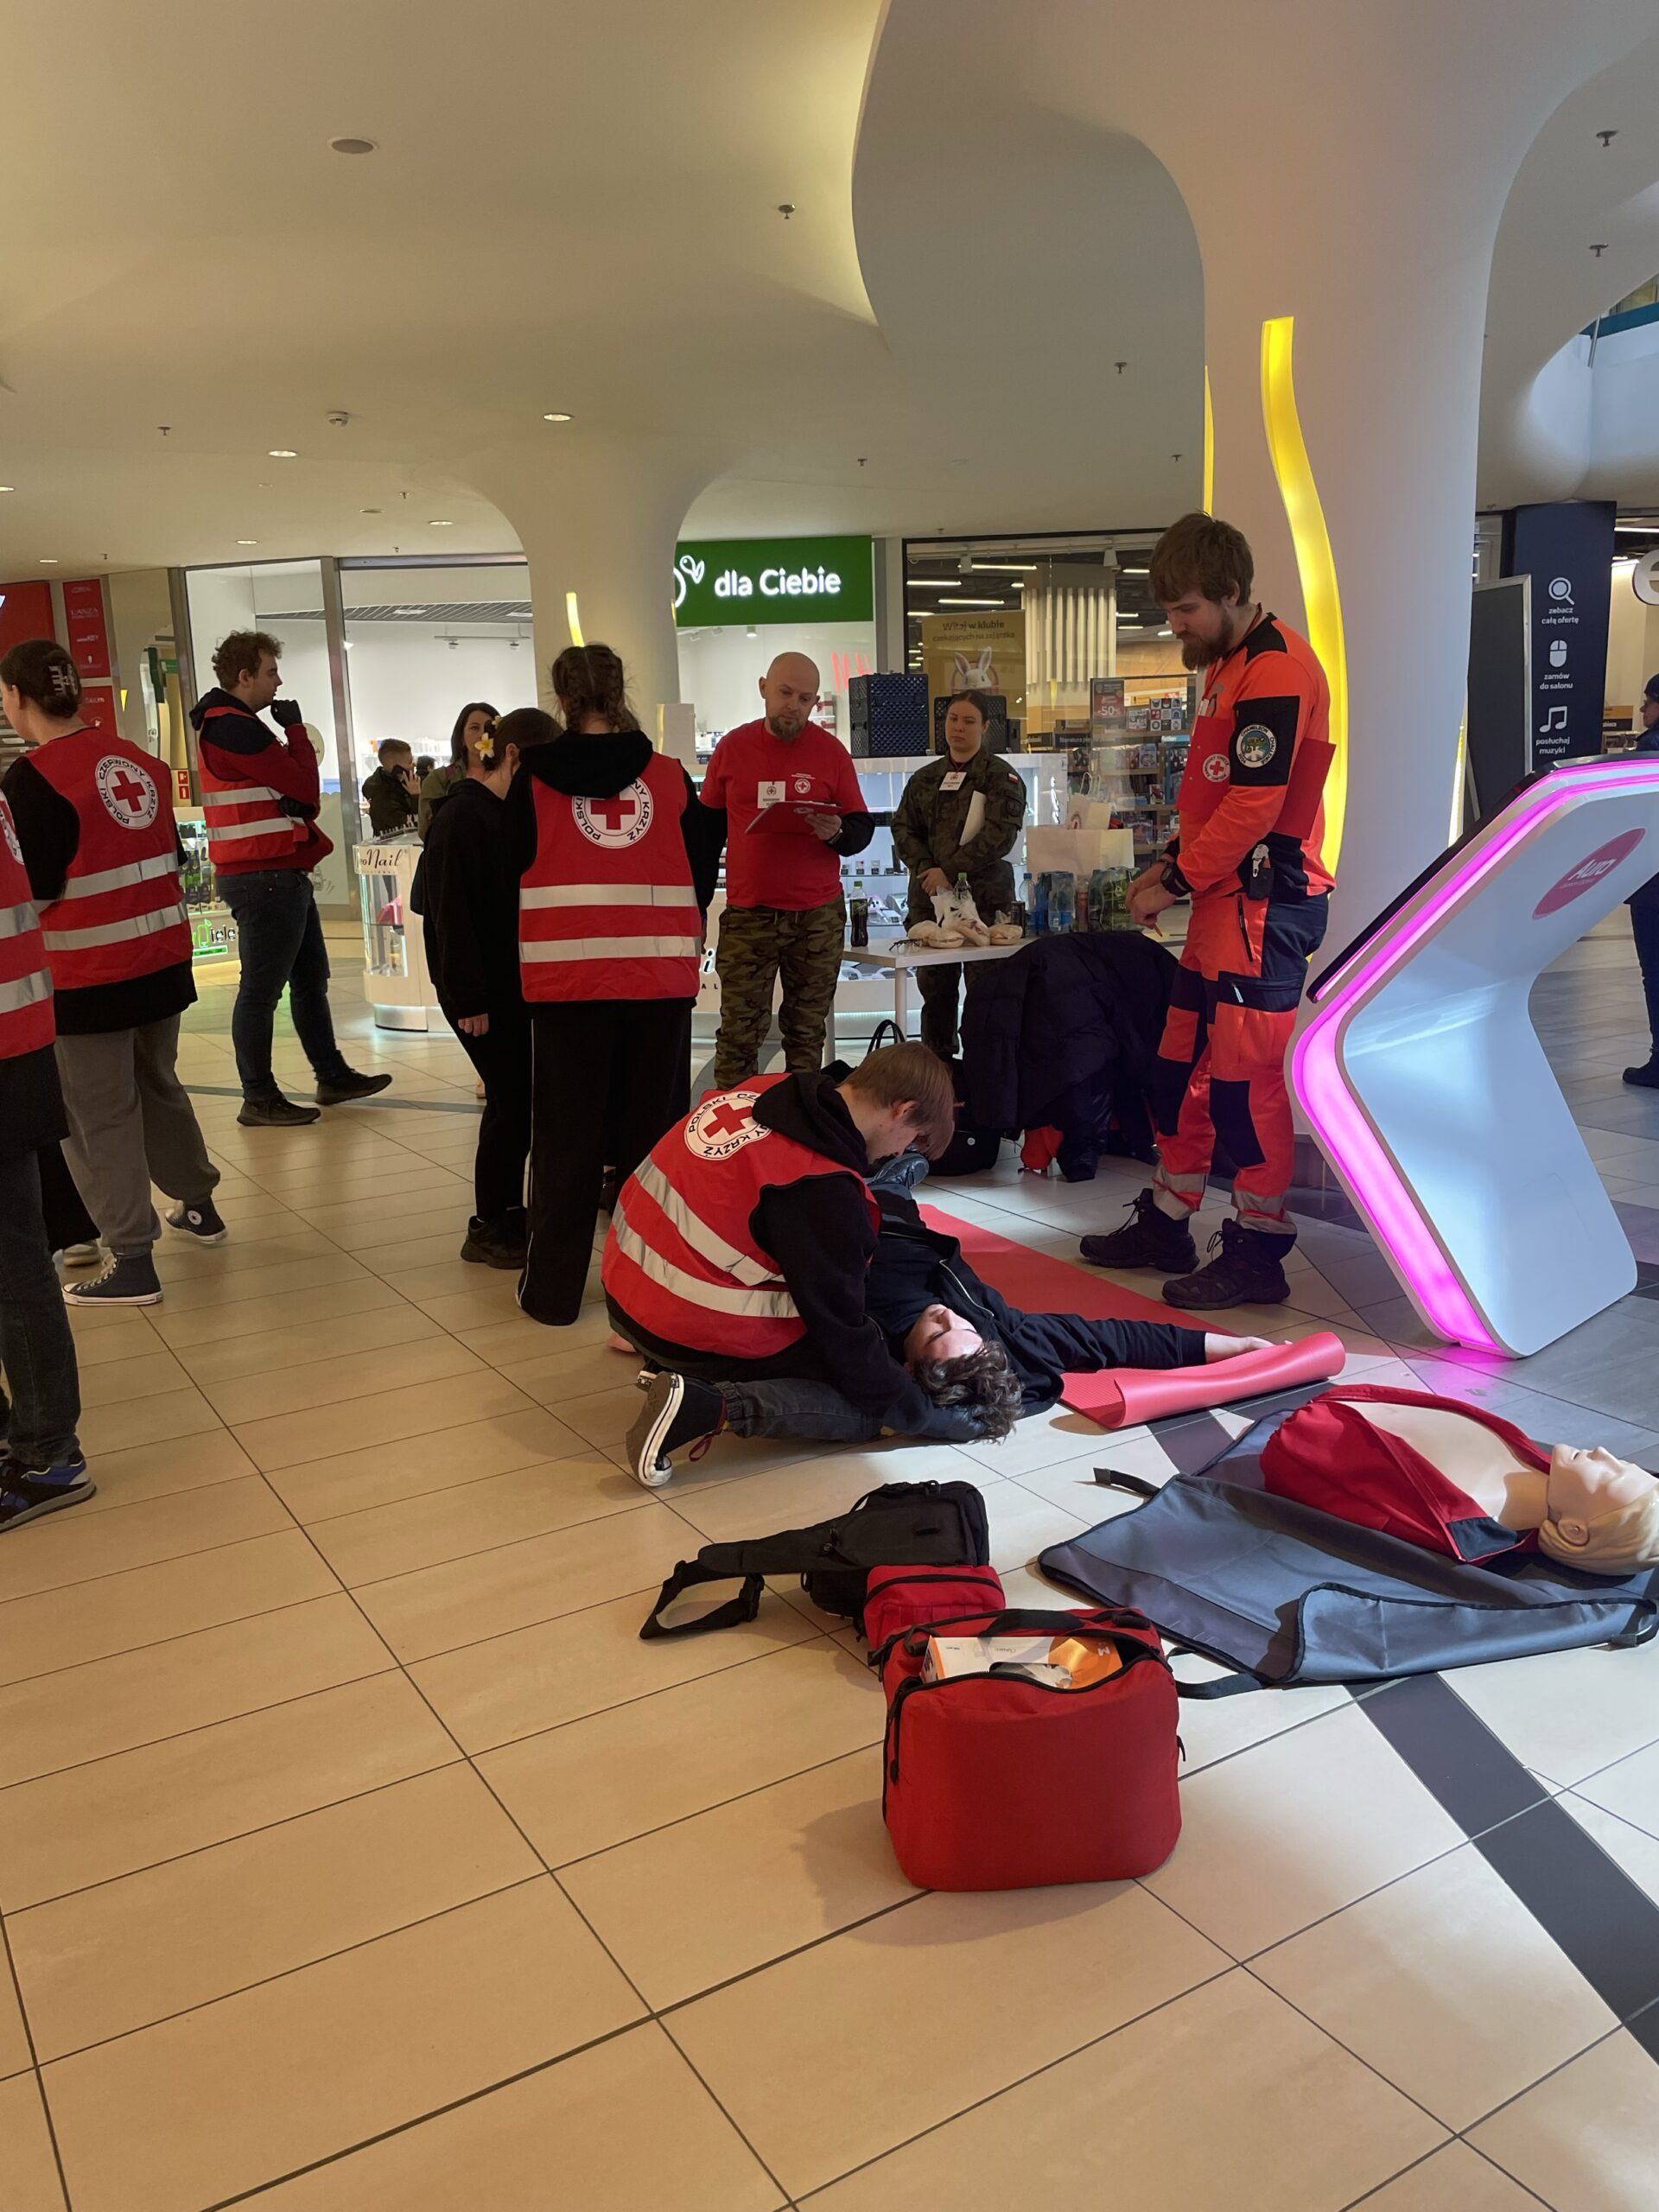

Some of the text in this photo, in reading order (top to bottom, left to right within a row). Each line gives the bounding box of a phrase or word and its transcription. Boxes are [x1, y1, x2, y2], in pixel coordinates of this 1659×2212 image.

[714, 565, 842, 597] dla Ciebie
[977, 620, 1005, 630] klubie
[1541, 616, 1580, 625] całą ofertę
[1543, 672, 1570, 681] zamów
[1539, 682, 1548, 690] do
[1535, 736, 1570, 746] posłuchaj
[1539, 746, 1566, 754] muzyki
[99, 759, 145, 780] CZERWONY
[99, 787, 130, 824] POLSKI
[575, 797, 601, 840] POLSKI
[688, 1096, 726, 1133] POLSKI
